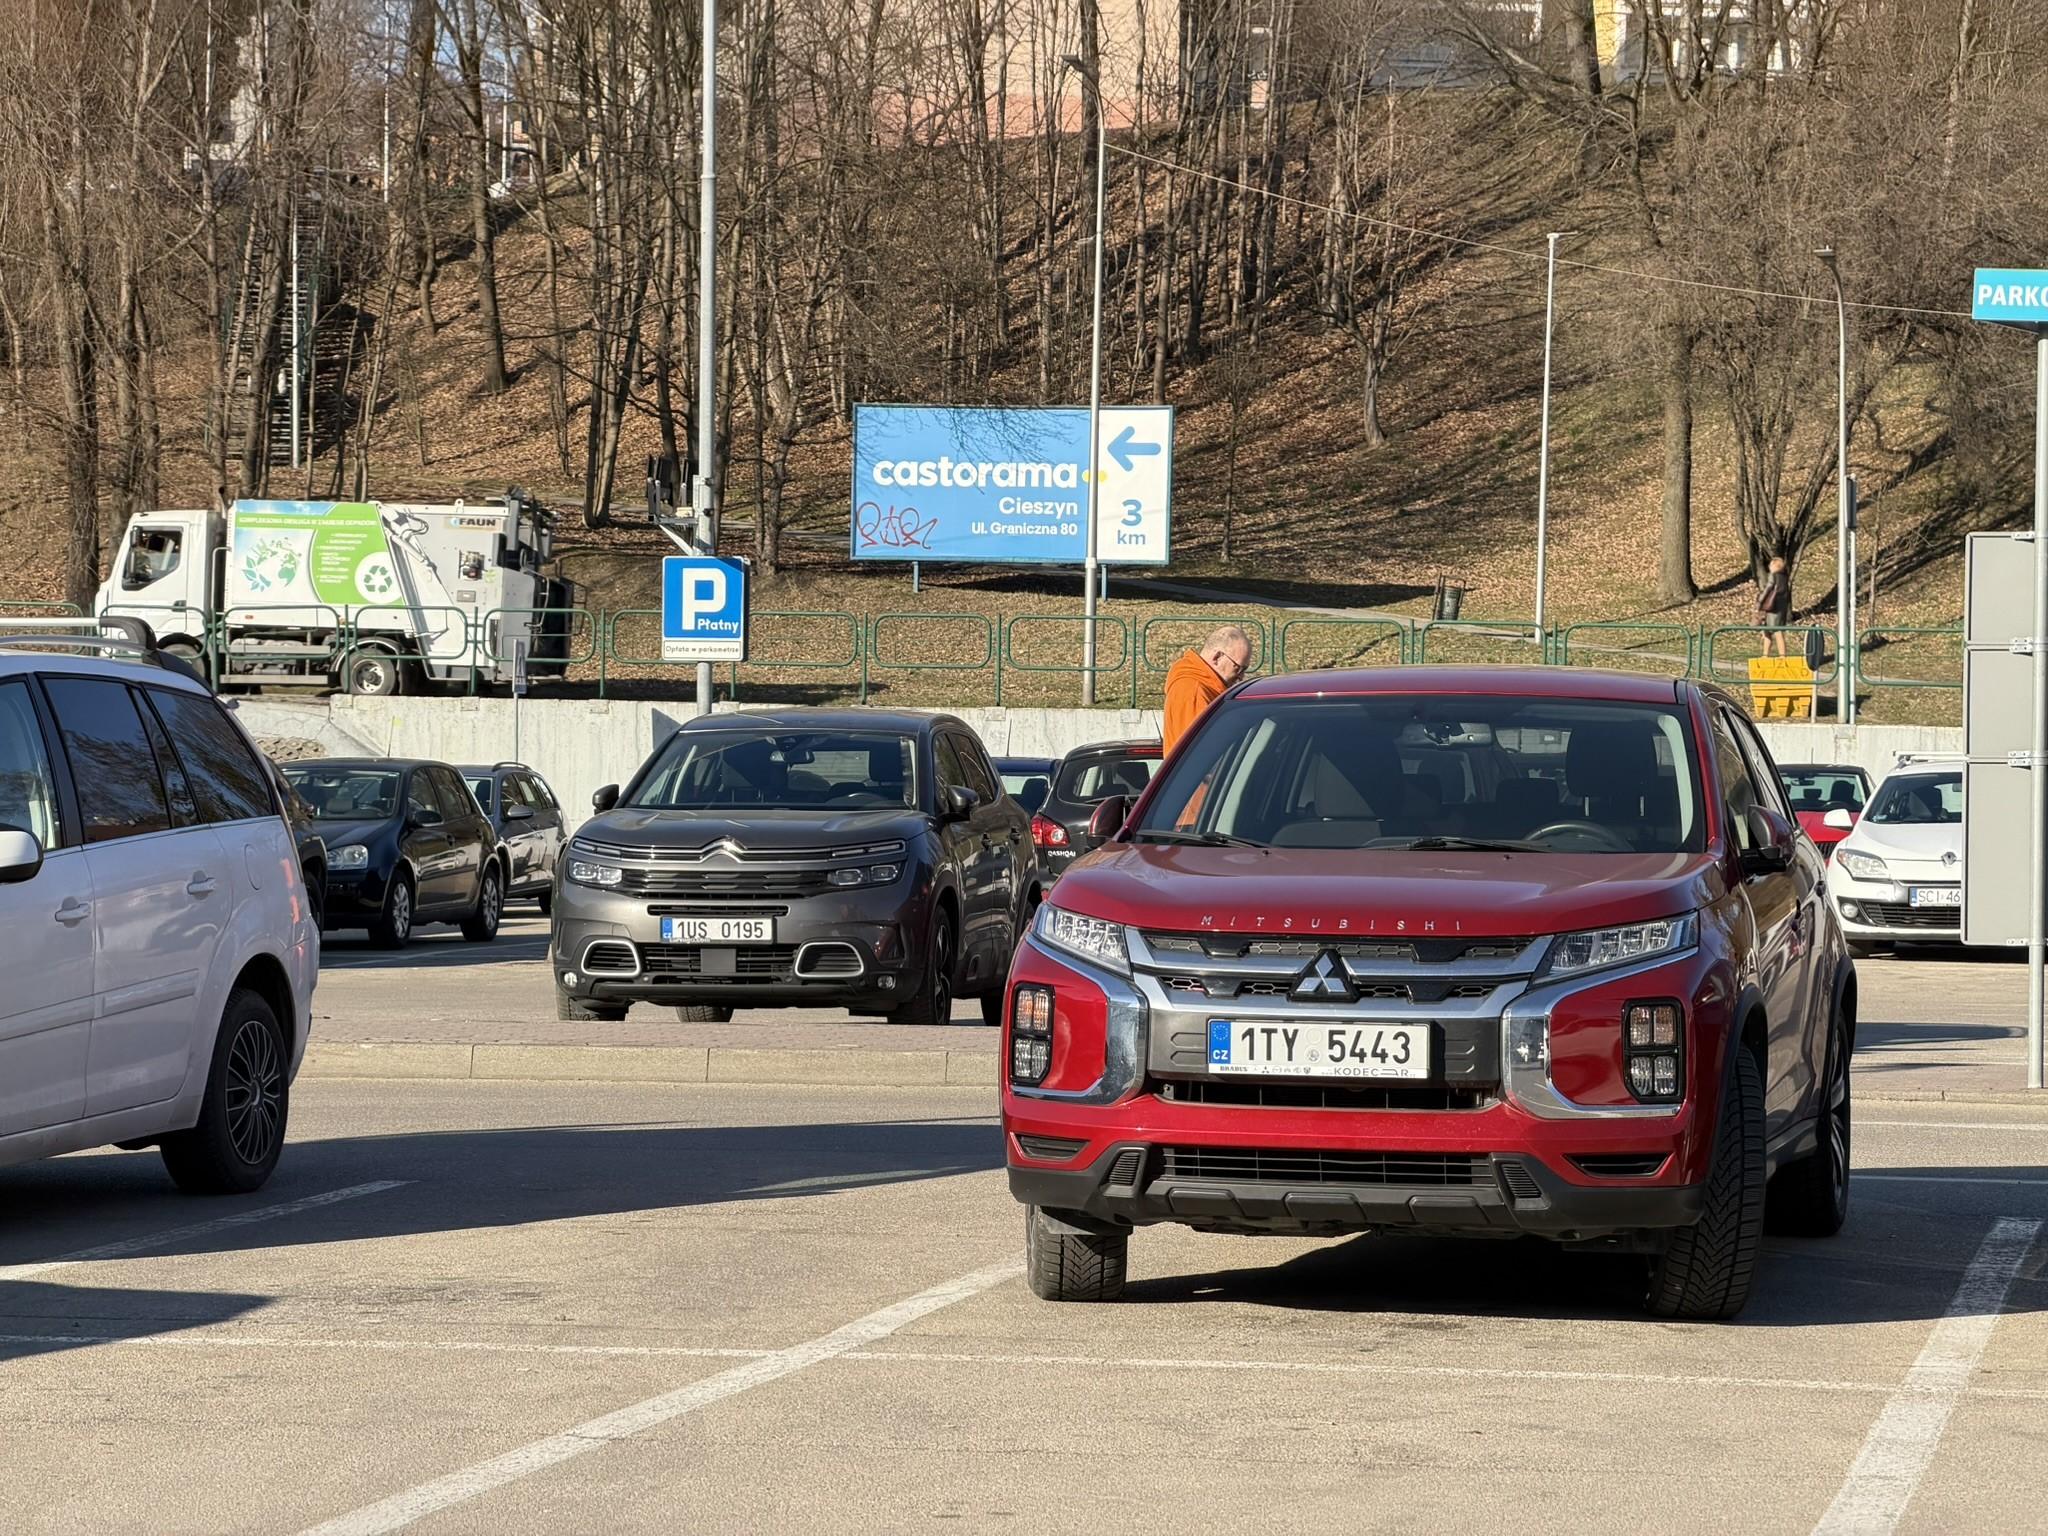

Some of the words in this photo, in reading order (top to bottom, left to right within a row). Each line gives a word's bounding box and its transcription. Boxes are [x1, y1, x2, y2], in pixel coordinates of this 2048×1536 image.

[872, 456, 1078, 488] castorama
[999, 497, 1079, 519] Cieszyn
[1121, 499, 1142, 527] 3
[460, 518, 496, 526] FAUN
[971, 522, 988, 535] Ul.
[990, 522, 1058, 536] Graniczna
[1060, 523, 1079, 536] 80
[1117, 529, 1146, 545] km
[682, 567, 727, 631] P
[697, 618, 739, 635] Płatny
[1919, 890, 1939, 903] SCI
[677, 921, 708, 939] 1US
[721, 921, 764, 939] 0195
[1200, 915, 1460, 931] MITSUBISHI
[1241, 1027, 1300, 1062] 1TY
[1328, 1029, 1411, 1064] 5443
[1213, 1049, 1229, 1060] CZ
